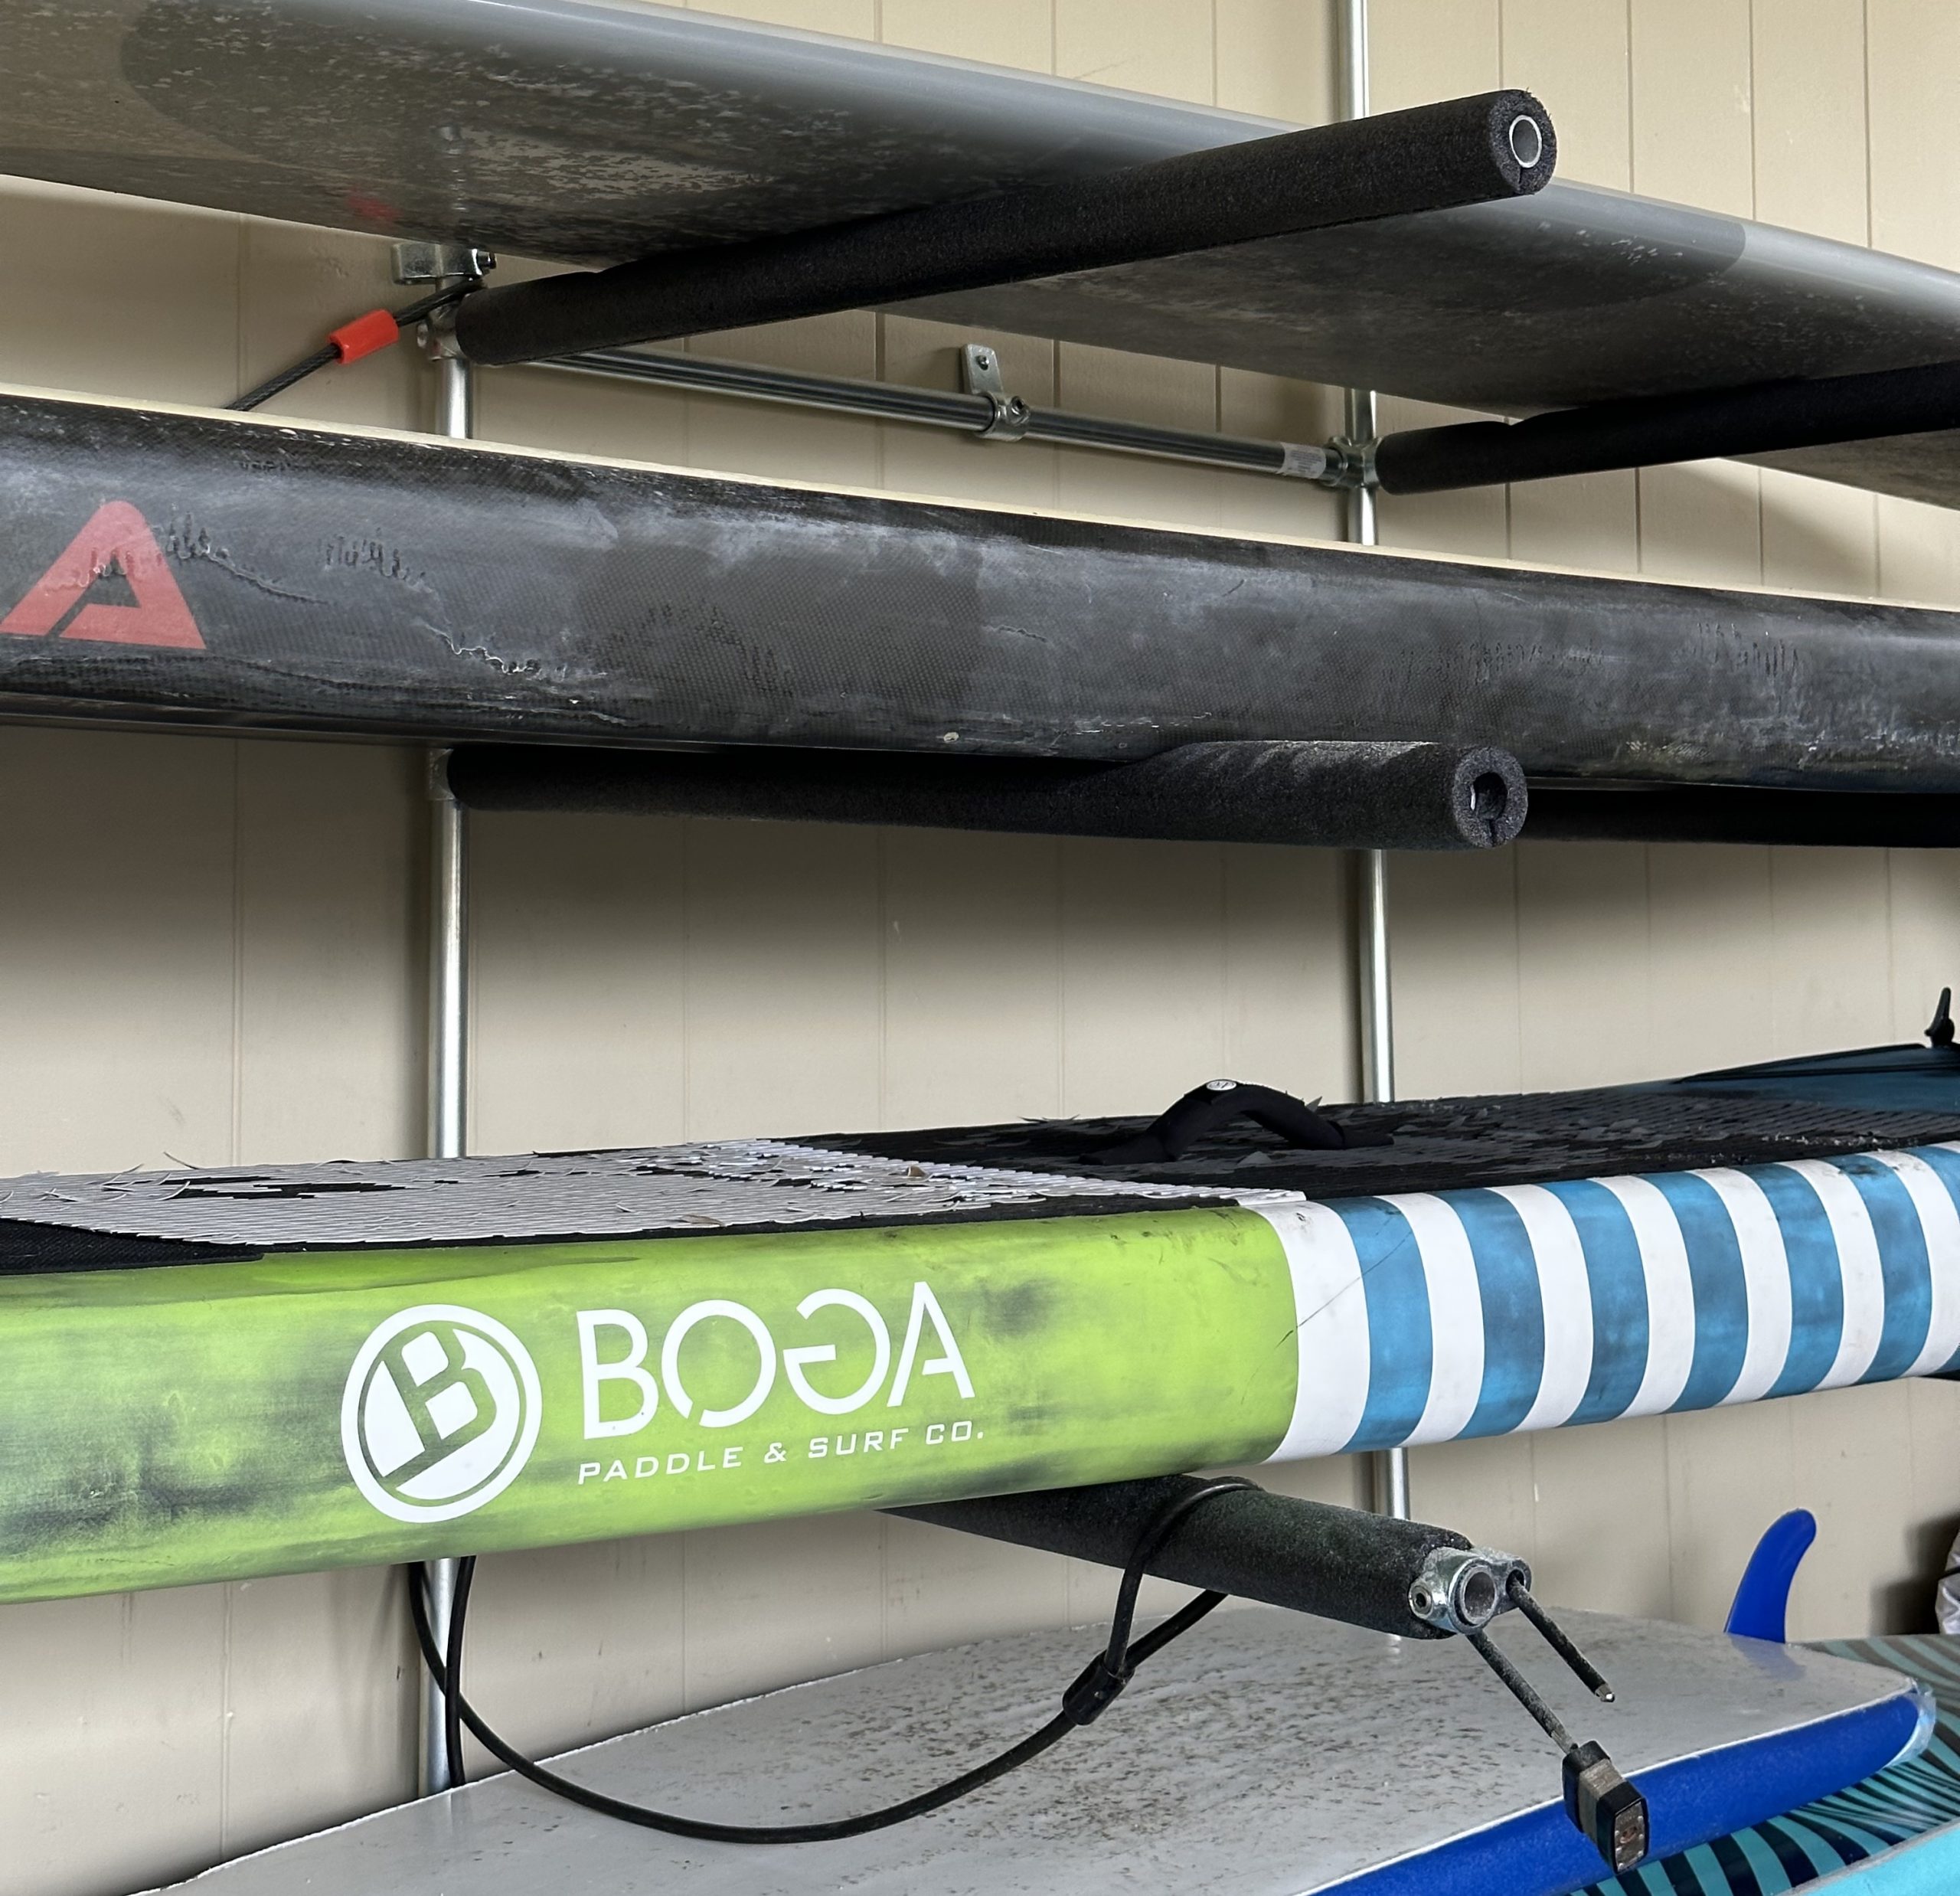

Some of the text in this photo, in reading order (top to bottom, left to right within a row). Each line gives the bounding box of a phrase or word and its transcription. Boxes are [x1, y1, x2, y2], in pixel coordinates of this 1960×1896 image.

[576, 1281, 975, 1440] BOGA
[578, 1420, 986, 1485] PADDLE & SURF CO.
